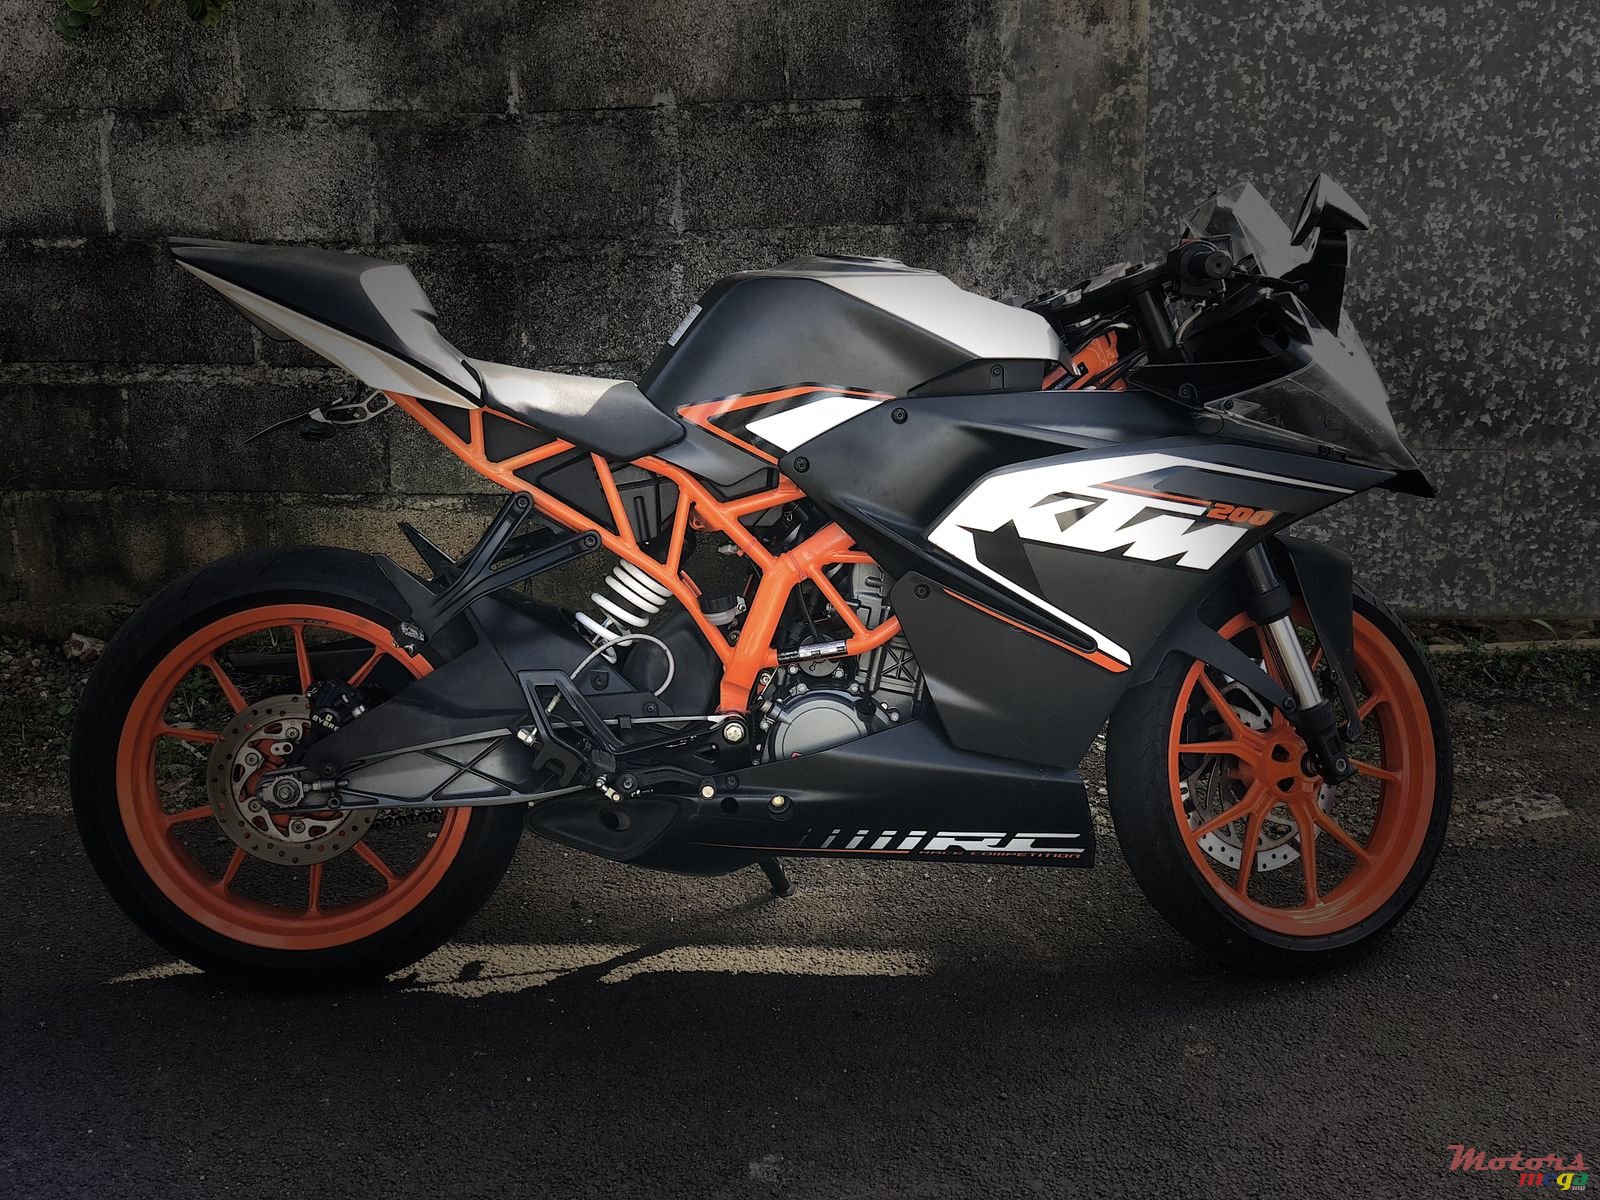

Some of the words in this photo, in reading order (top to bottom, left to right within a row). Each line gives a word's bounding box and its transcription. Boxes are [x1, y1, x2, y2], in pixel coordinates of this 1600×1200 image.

[1003, 489, 1248, 571] KTM
[1206, 502, 1276, 526] 200
[924, 831, 1086, 852] RC
[970, 850, 1082, 860] COMPETITION
